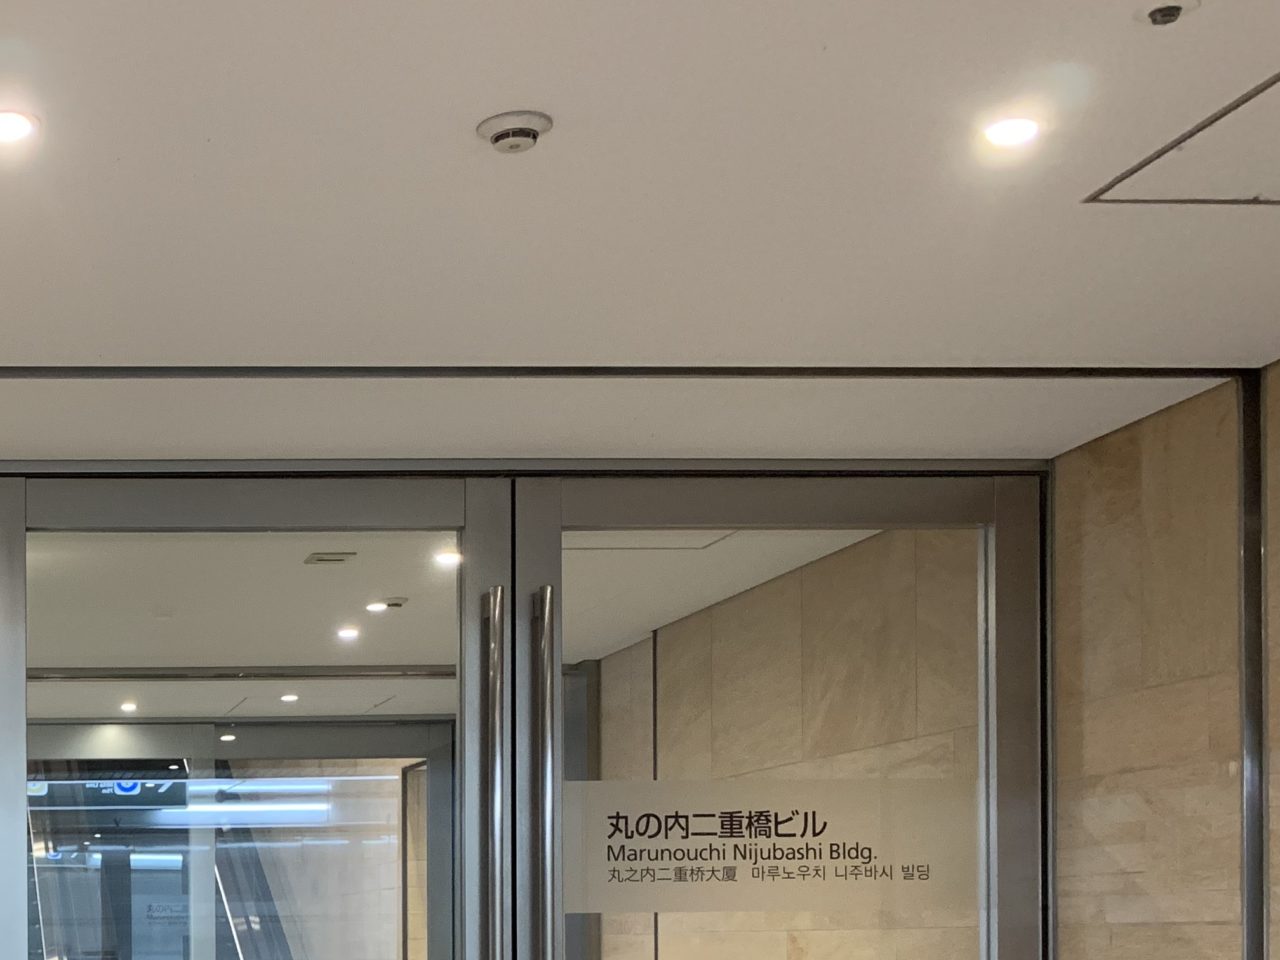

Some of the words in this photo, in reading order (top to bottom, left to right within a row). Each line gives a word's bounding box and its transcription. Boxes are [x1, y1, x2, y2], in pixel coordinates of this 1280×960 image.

[607, 810, 828, 839] 丸の内二重橋ビル
[607, 842, 726, 861] Marunouchi
[733, 842, 823, 865] Nijubashi
[829, 842, 878, 865] Bldg.
[607, 866, 738, 883] 丸之内二重桥大厦
[751, 865, 826, 881] 마루노우치
[834, 865, 893, 881] 니주바시
[901, 864, 930, 881] 빌딩
